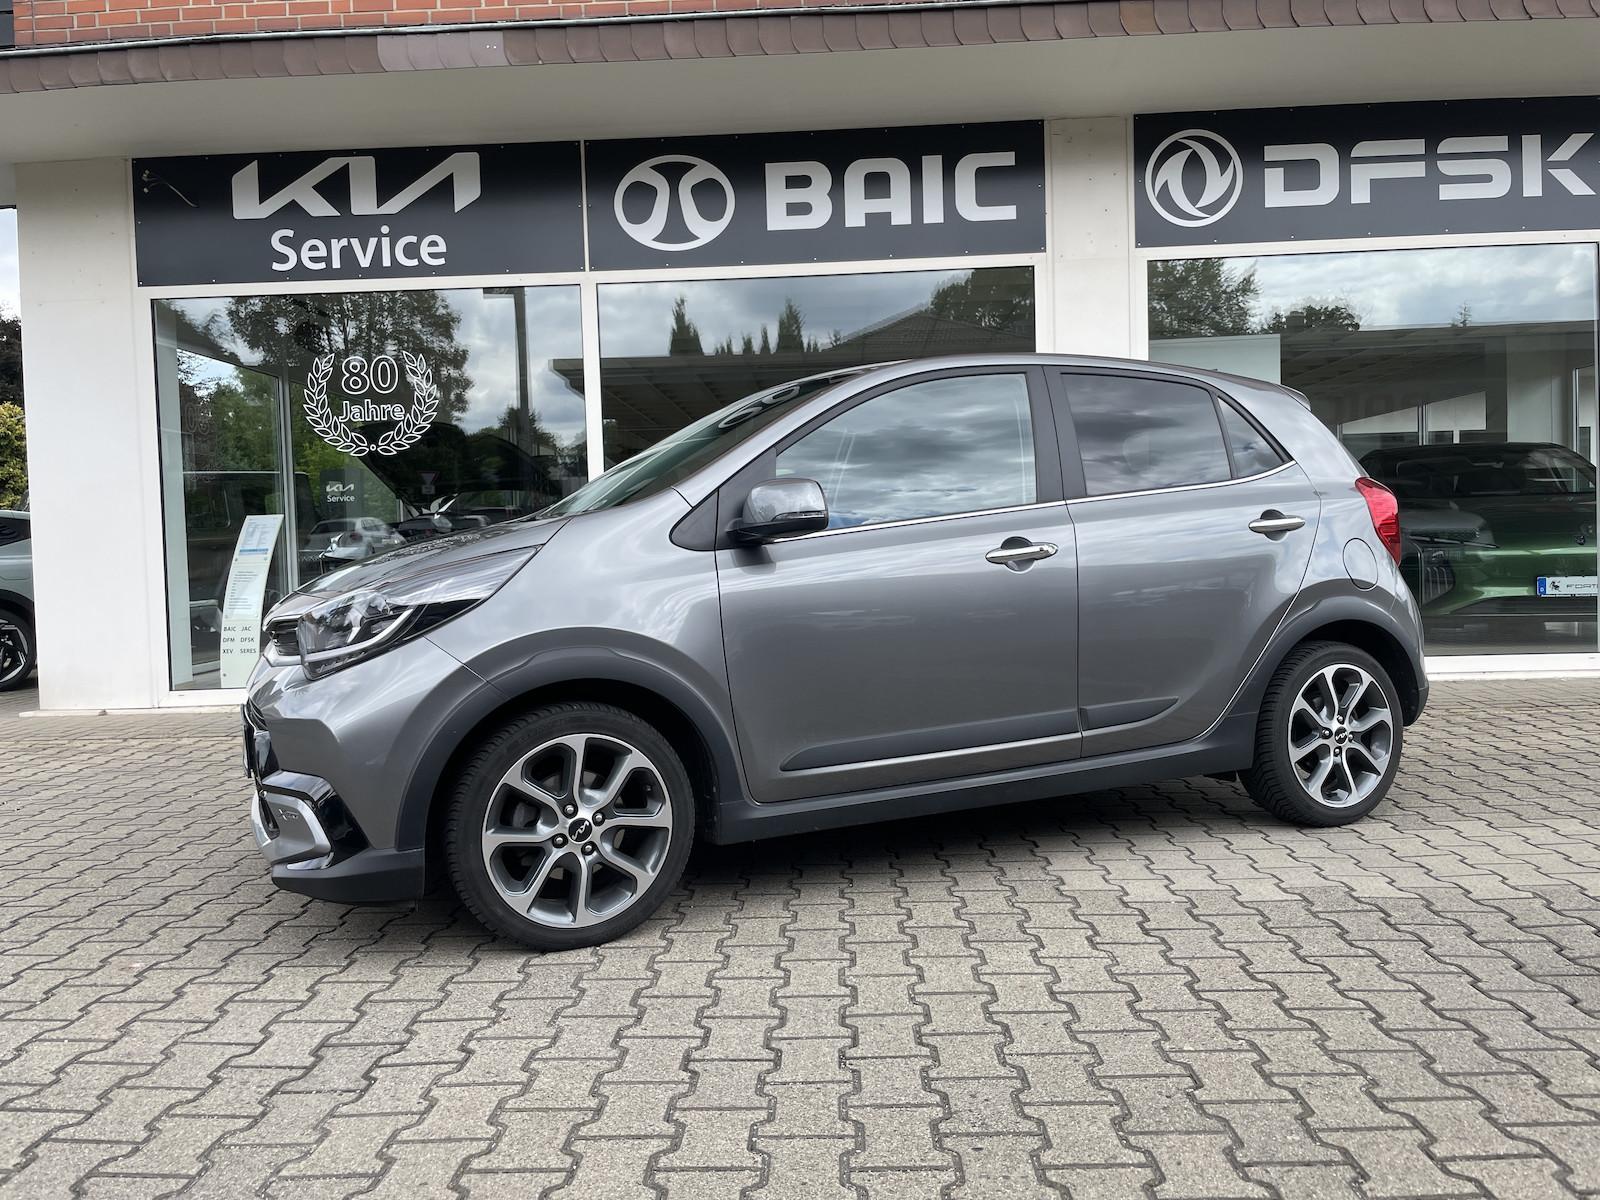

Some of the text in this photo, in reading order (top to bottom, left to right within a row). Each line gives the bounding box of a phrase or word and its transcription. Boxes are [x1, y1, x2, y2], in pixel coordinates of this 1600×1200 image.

[231, 152, 481, 220] KIA
[765, 151, 1017, 231] BAIC
[1264, 133, 1596, 208] DFSK
[270, 225, 447, 272] Service
[341, 355, 399, 395] 80
[339, 399, 405, 422] Jahre
[327, 494, 356, 503] Service
